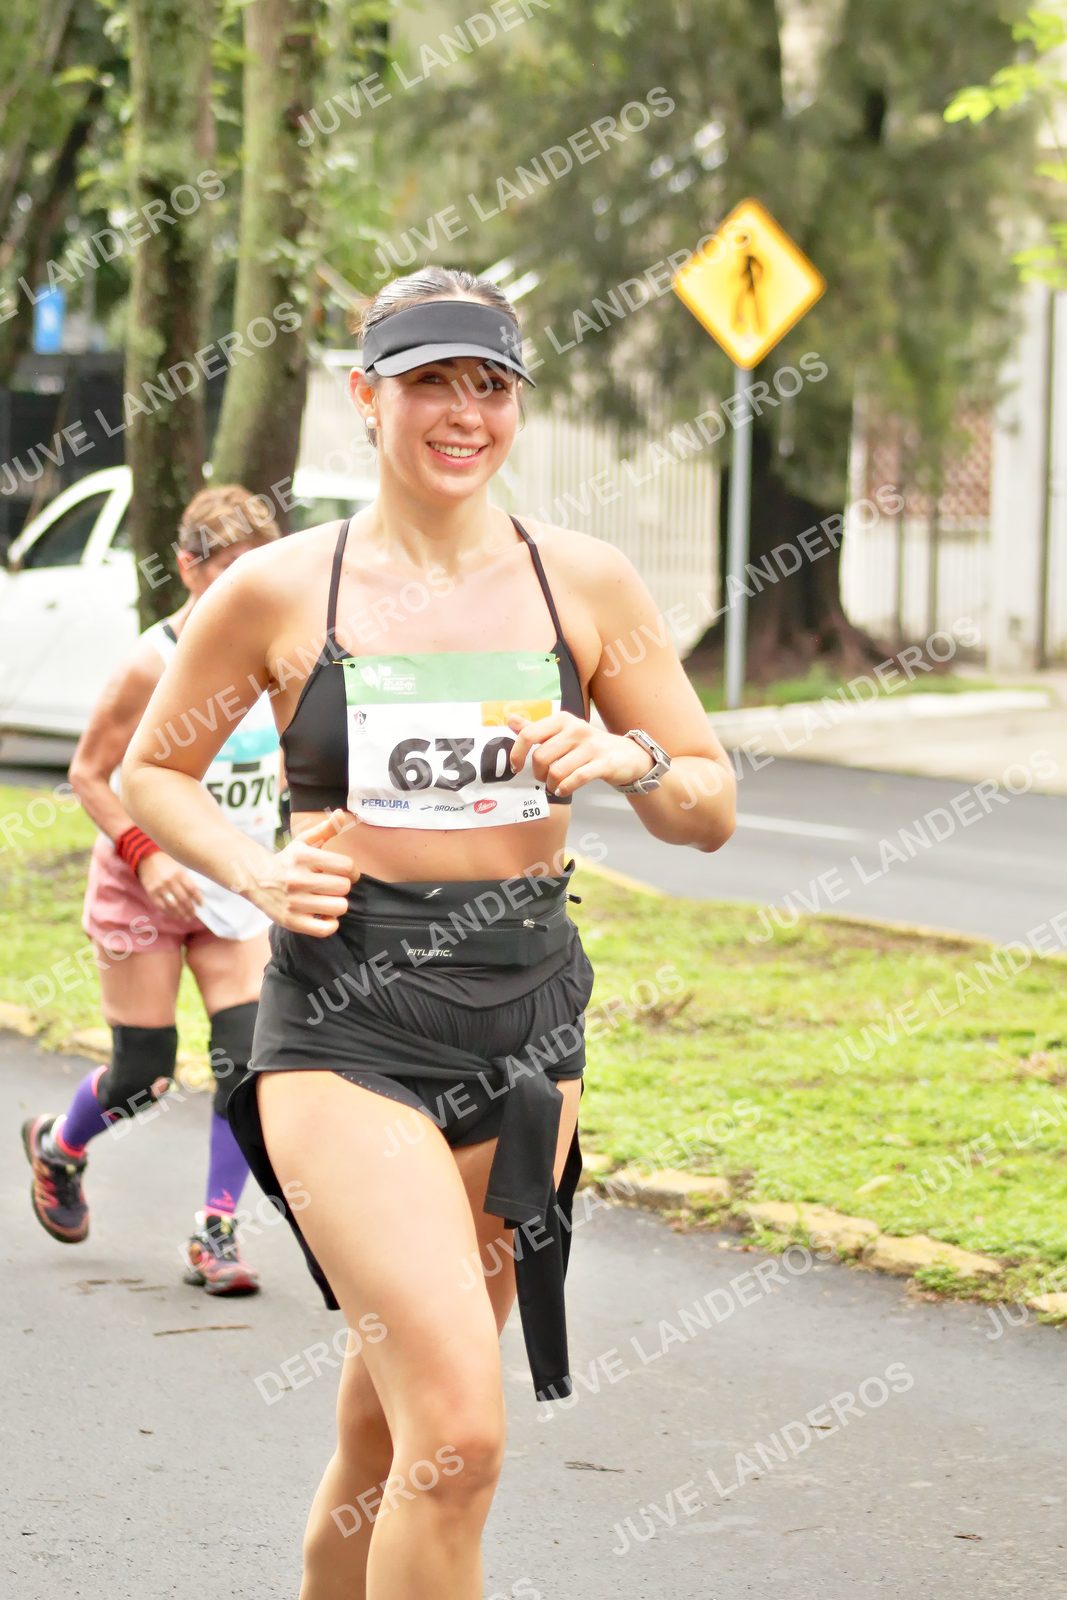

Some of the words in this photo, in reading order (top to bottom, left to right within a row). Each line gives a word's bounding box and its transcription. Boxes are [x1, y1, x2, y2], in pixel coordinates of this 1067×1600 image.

[388, 736, 517, 791] 630
[361, 798, 410, 810] PERDURA
[522, 807, 541, 819] 630
[407, 948, 450, 957] FITLETIC
